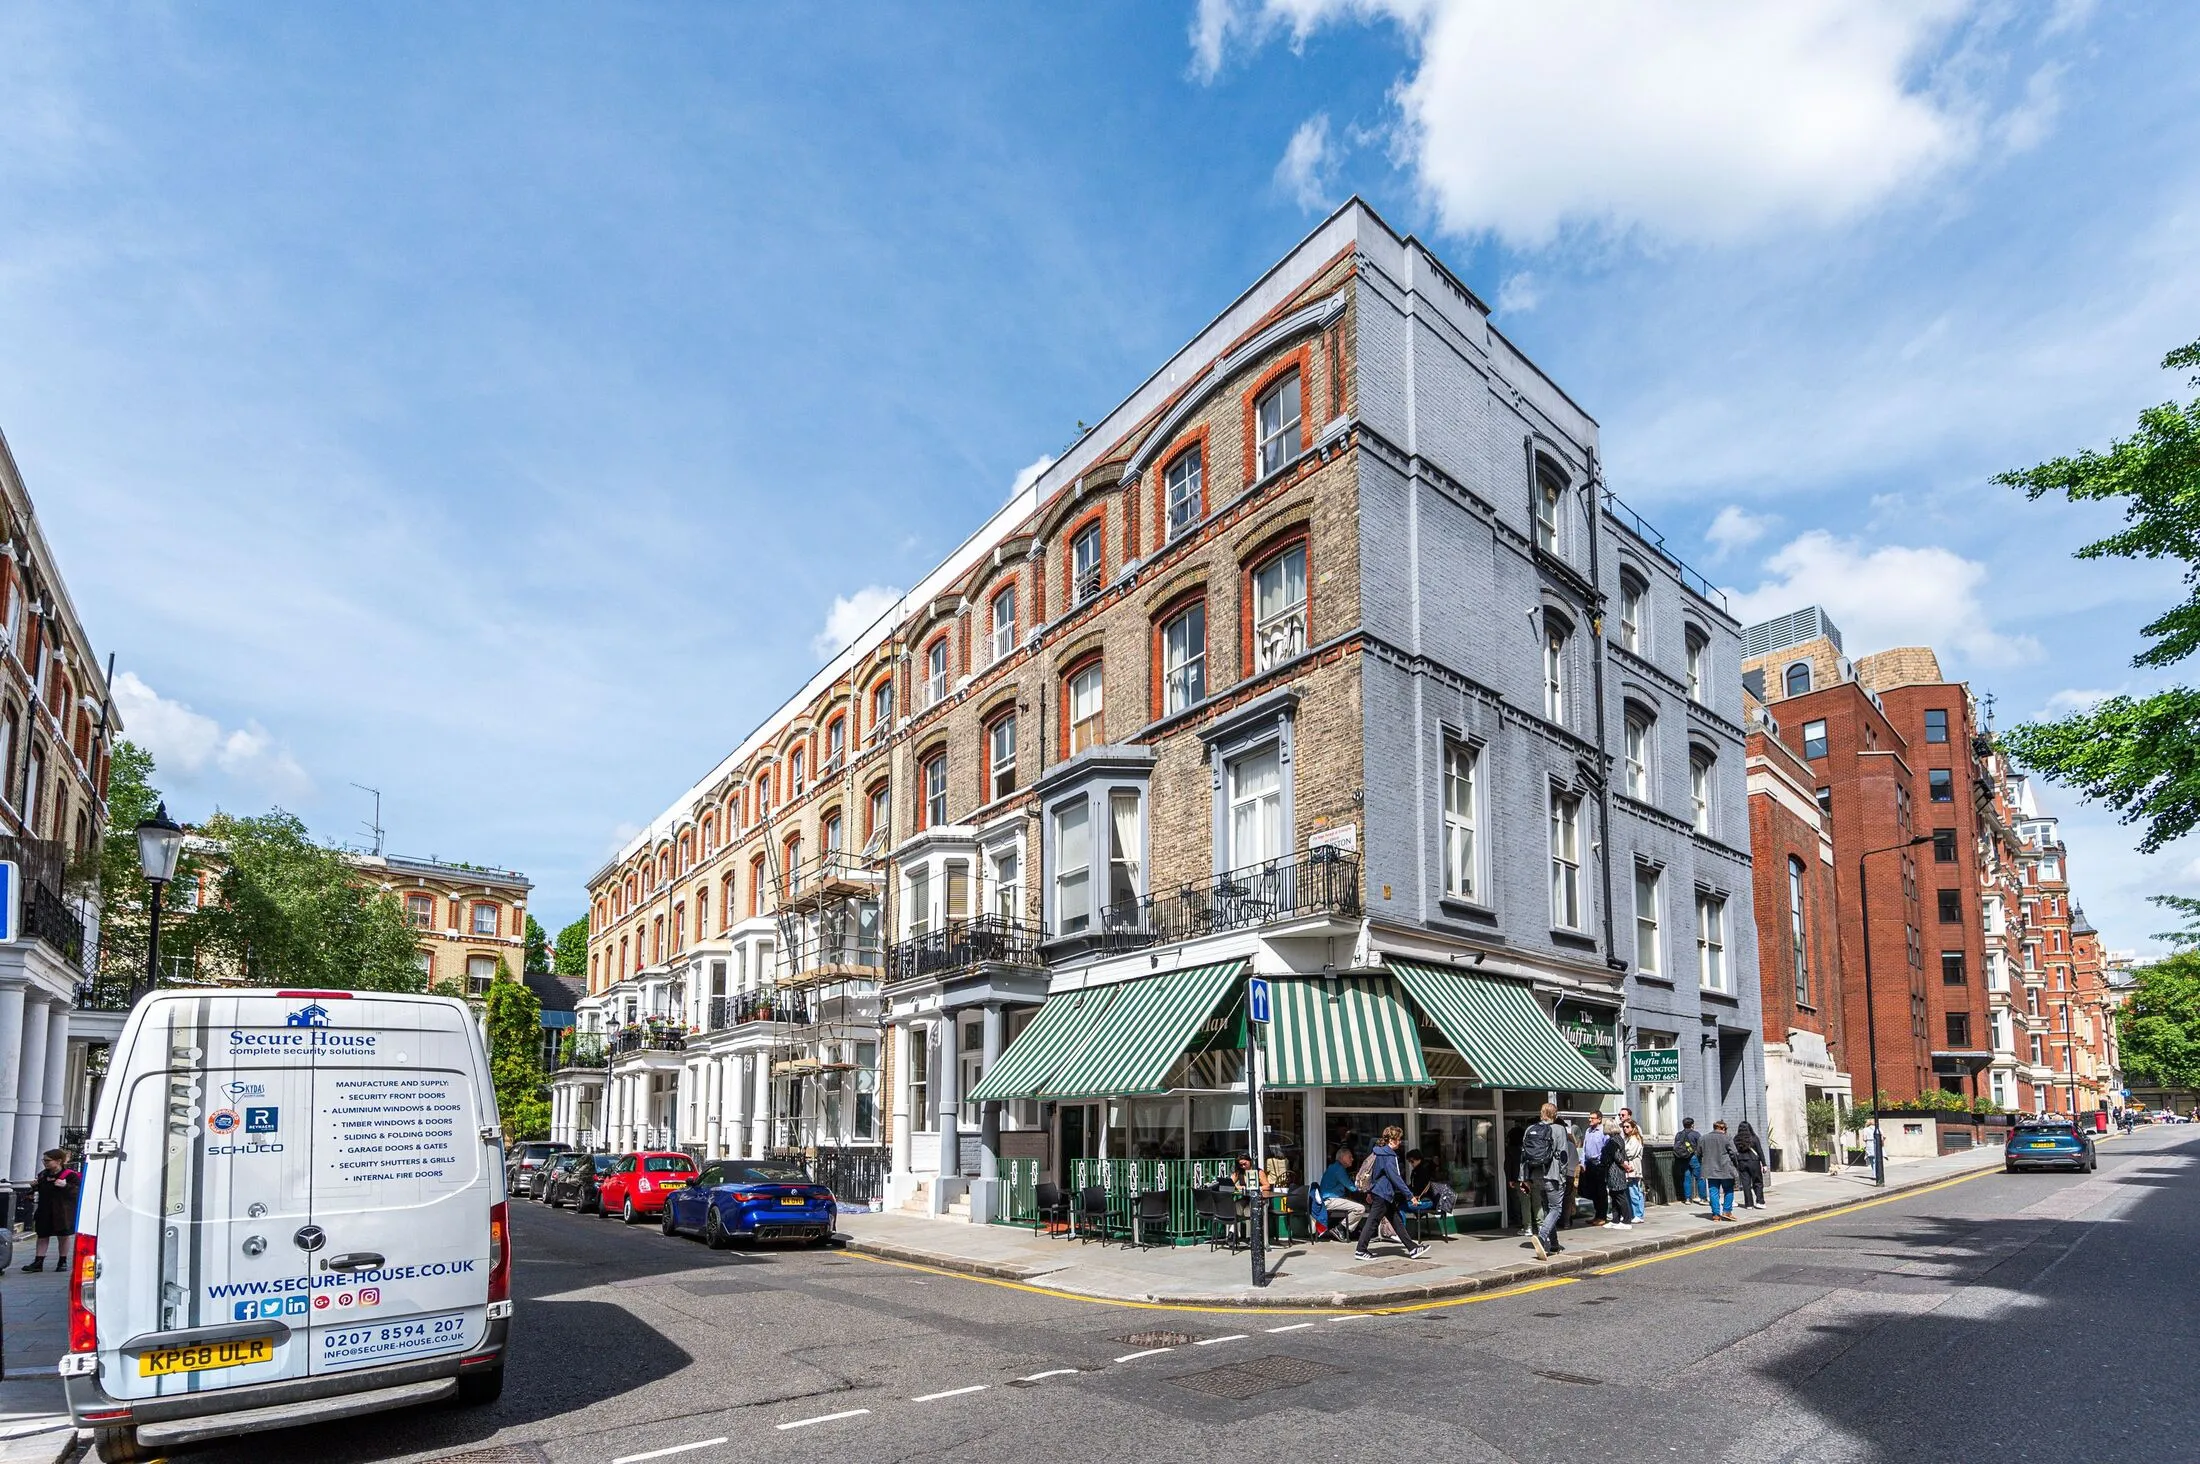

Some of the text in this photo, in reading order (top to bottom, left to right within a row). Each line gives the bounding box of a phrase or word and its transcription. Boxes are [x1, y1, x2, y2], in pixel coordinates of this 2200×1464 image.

[1580, 1011, 1593, 1024] The
[230, 1030, 303, 1046] Secure
[310, 1031, 376, 1046] House
[1561, 1025, 1613, 1048] Muffin Man
[229, 1047, 376, 1056] complete security solutions
[1633, 1056, 1678, 1067] Muffin Man
[230, 1081, 265, 1094] SKYDAS
[348, 1093, 388, 1101] SECURITY
[332, 1106, 382, 1114] ALUMINIUM
[254, 1109, 269, 1125] R
[374, 1119, 416, 1127] WINDOWS
[387, 1131, 424, 1139] FOLDING
[347, 1146, 383, 1154] GARAGE
[385, 1144, 414, 1152] DOORS
[339, 1161, 379, 1169] SECURITY
[380, 1158, 420, 1167] SHUTTERS
[430, 1156, 455, 1164] GRILLS
[353, 1170, 443, 1182] INTERNAL FIRE DOORS
[208, 1259, 475, 1299] WWW.SECURE-HOUSE.CO.UK
[325, 1318, 464, 1348] 0207 8594 207
[324, 1332, 464, 1359] INFO@SECURE-HOUSE.CO.UK
[150, 1340, 264, 1371] KP68 ULR
